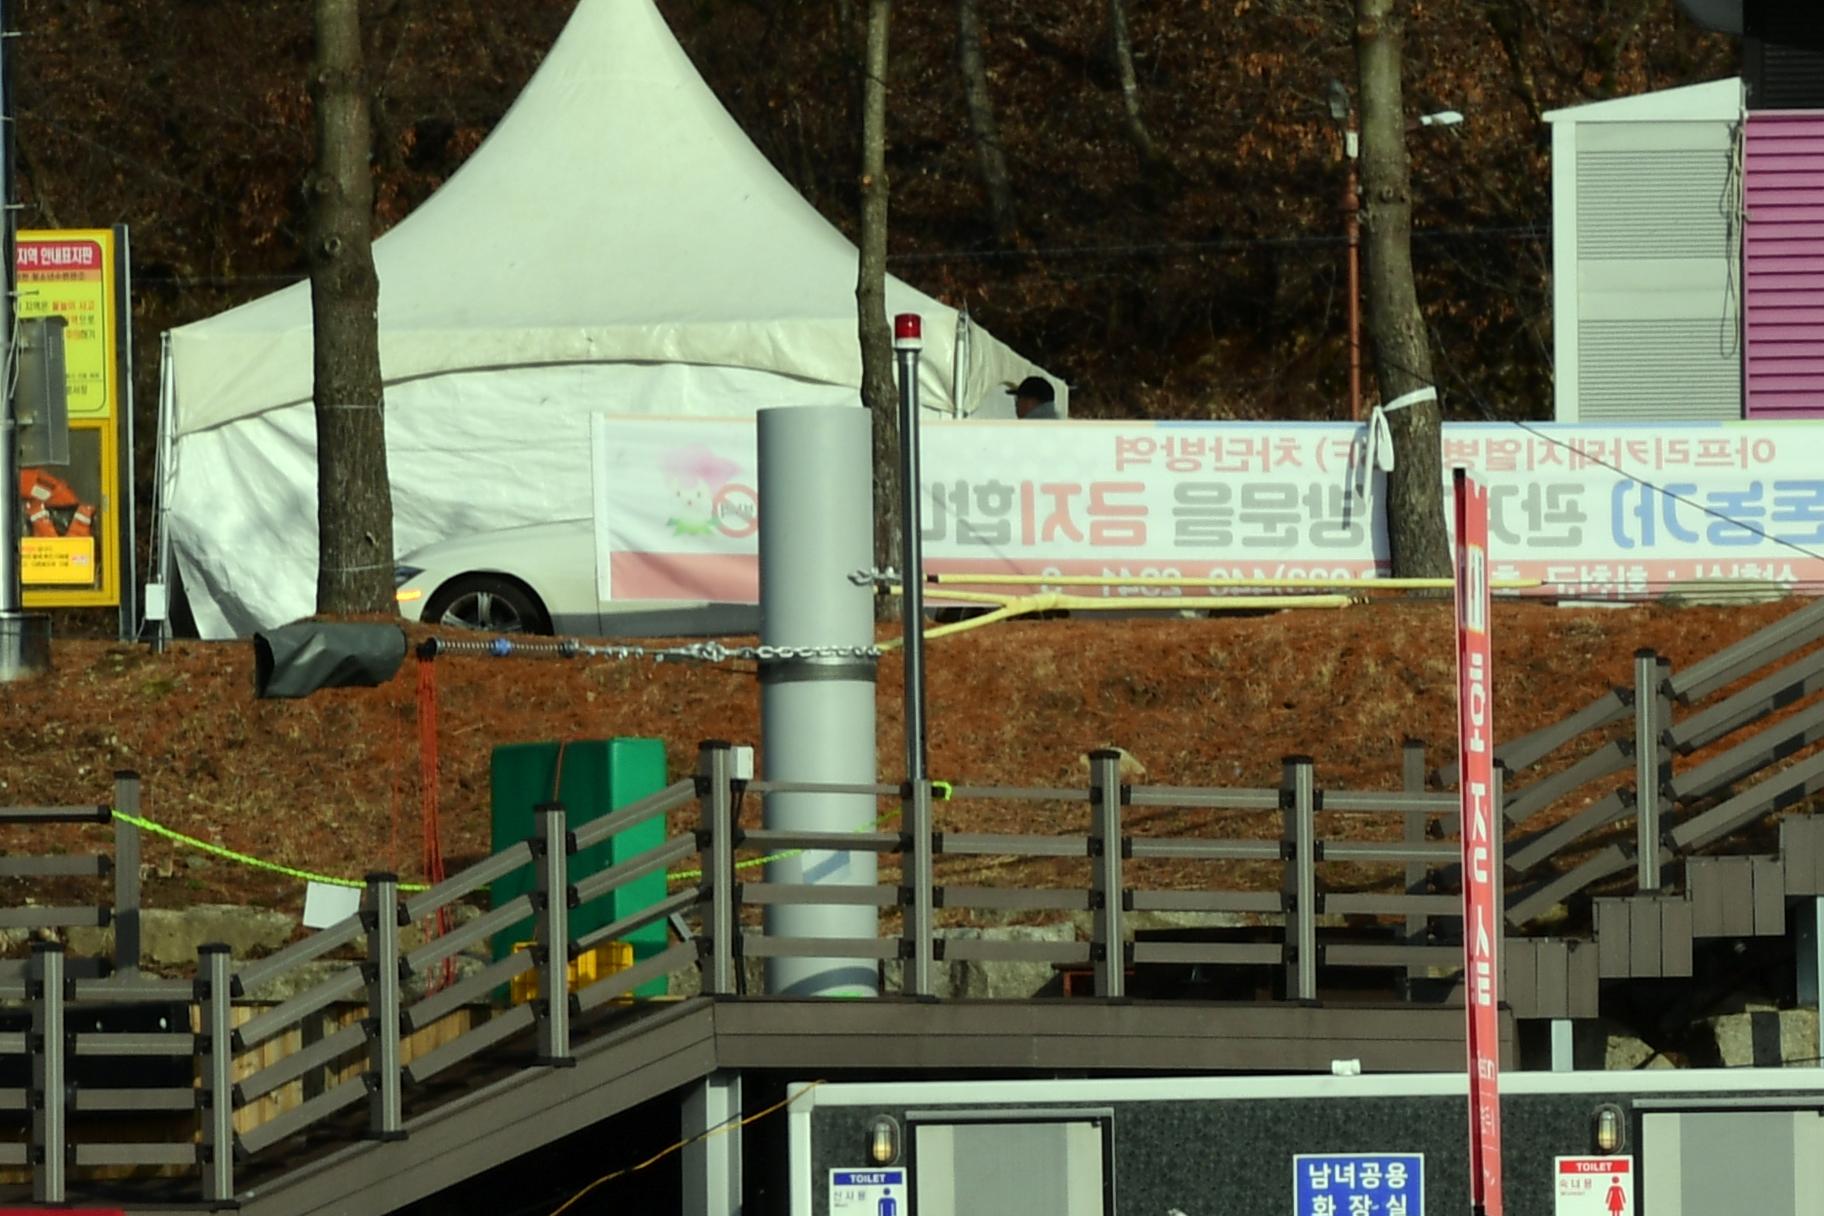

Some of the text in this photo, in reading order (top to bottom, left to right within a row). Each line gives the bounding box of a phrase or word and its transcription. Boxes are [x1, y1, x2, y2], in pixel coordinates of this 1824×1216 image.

[1575, 1161, 1614, 1173] TOILET
[848, 1173, 887, 1185] TOILET
[1308, 1161, 1409, 1190] 남녀공용
